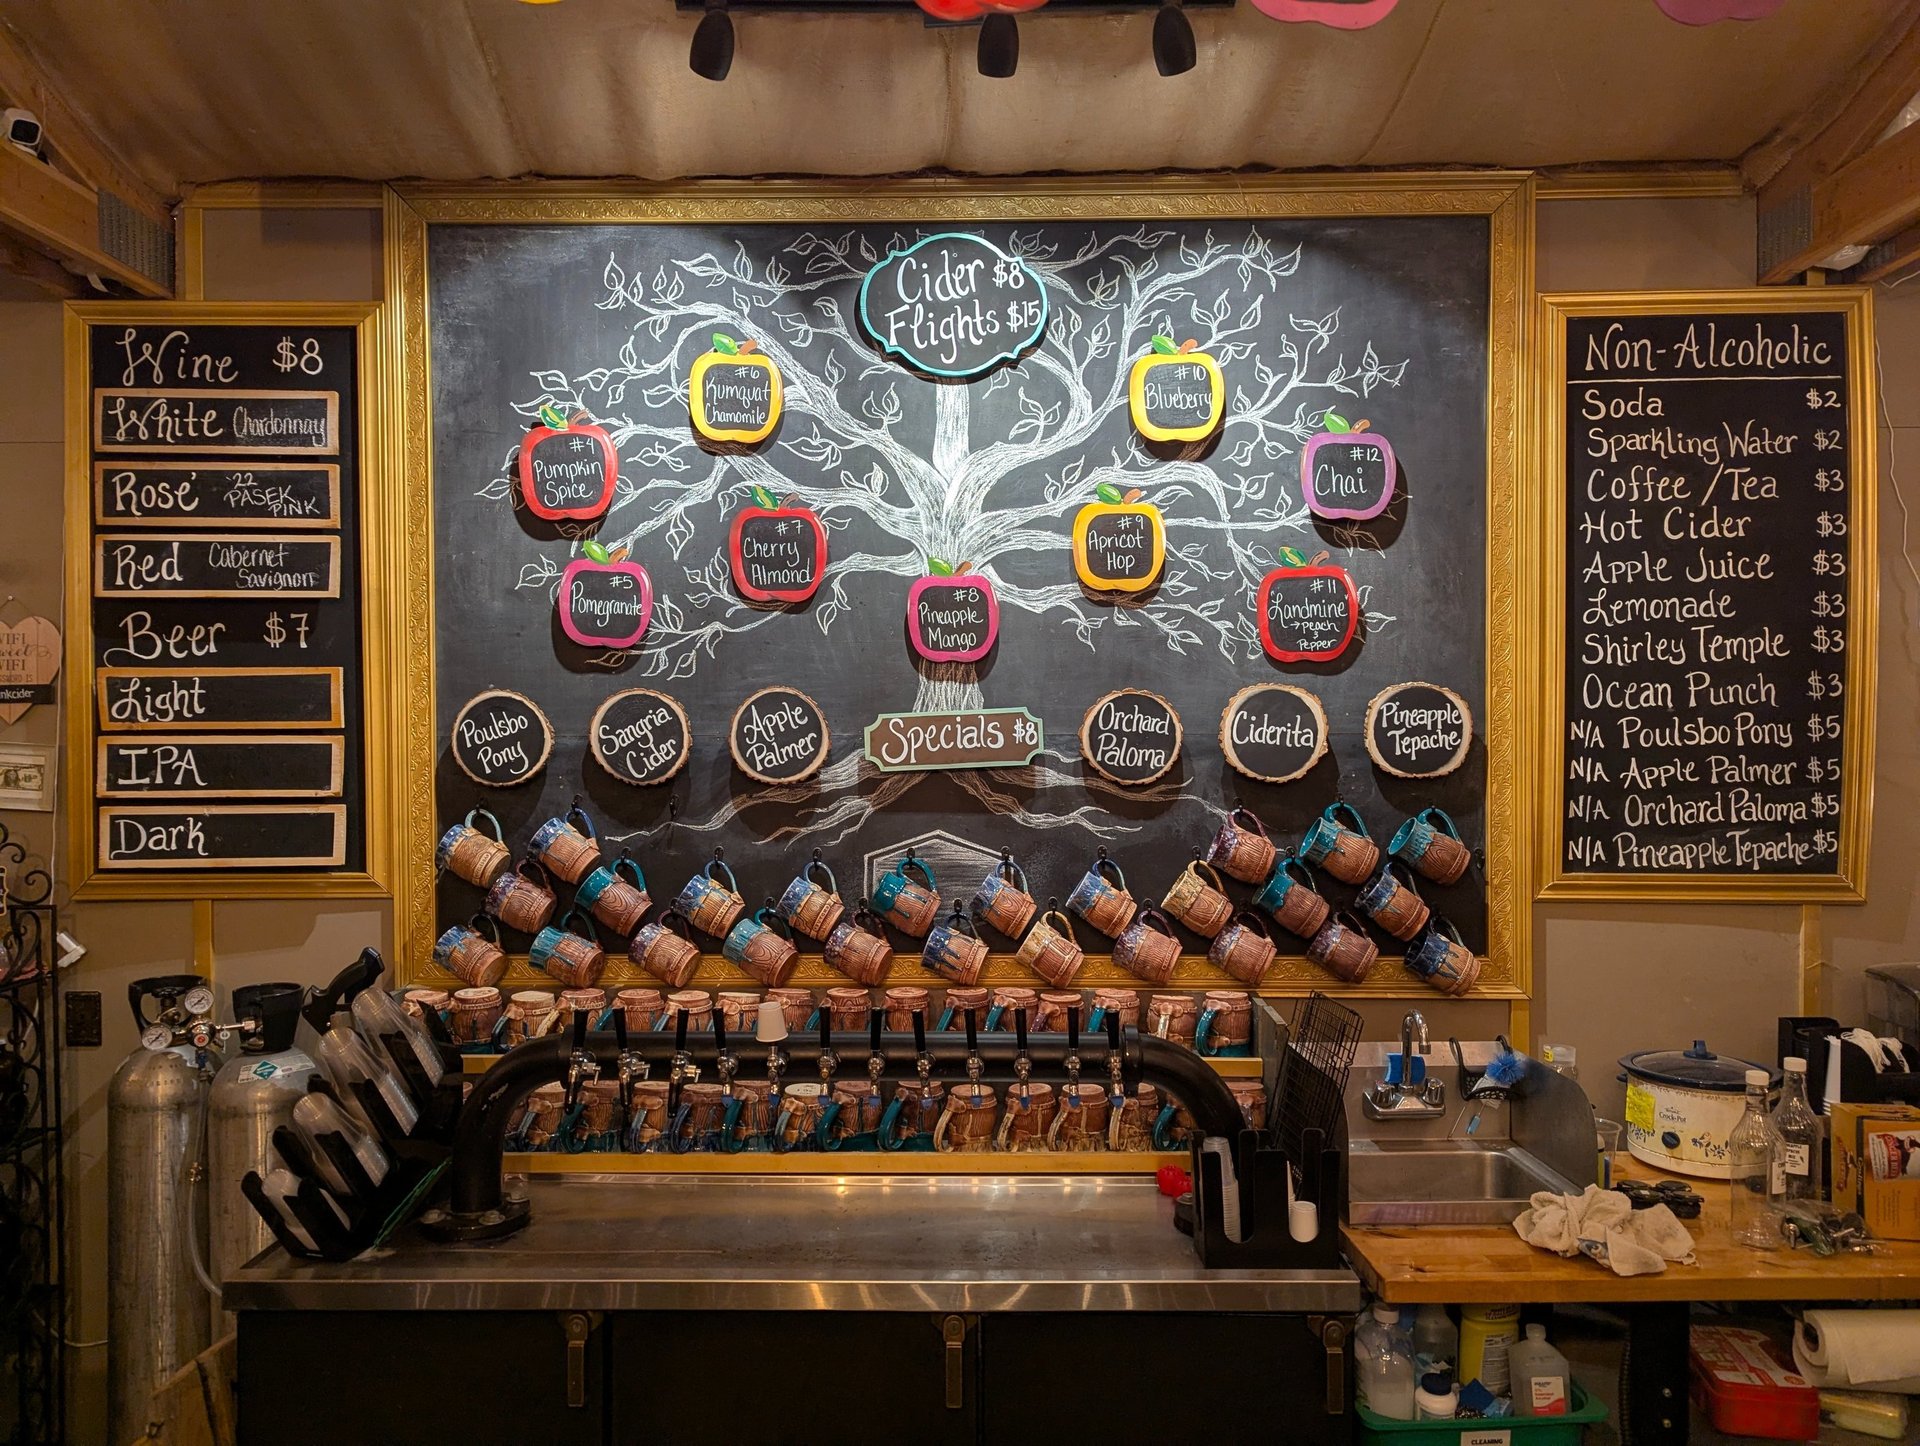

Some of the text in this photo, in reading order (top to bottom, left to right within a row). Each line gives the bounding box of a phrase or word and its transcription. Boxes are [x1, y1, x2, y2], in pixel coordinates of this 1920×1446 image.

[897, 249, 1025, 303] Cider $8
[884, 299, 1041, 365] Flights $15
[115, 328, 323, 386] Wine $8
[734, 366, 760, 379] #6
[1174, 366, 1207, 382] #10
[706, 380, 771, 411] Kumquat
[1144, 383, 1213, 419] Blueberry
[1582, 387, 1841, 421] Soda $2
[108, 397, 325, 447] White Chardonnay
[705, 403, 767, 425] Chamomile
[569, 437, 595, 454] #4
[1350, 447, 1383, 462] #12
[1587, 419, 1844, 465] Sparkling Water $2
[534, 460, 604, 482] Pumpkin
[1315, 463, 1367, 496] Chai
[1814, 468, 1844, 492] $3
[223, 484, 296, 508] PASEK
[268, 496, 320, 517] PINK
[544, 482, 594, 507] Spice
[775, 520, 804, 536] #7
[1117, 515, 1145, 530] #9
[1579, 506, 1847, 544] Hot Cider $3
[208, 542, 289, 568] Cabernet
[743, 537, 800, 567] Cherry
[1088, 530, 1144, 551] Apricot
[112, 542, 183, 589] Red
[751, 558, 815, 586] Almond
[1106, 551, 1136, 574] Hop
[1583, 547, 1847, 584] Apple Juice $3
[609, 575, 633, 589] #5
[952, 588, 980, 602] #8
[1309, 579, 1336, 594] #11
[571, 581, 646, 627] Pomegranate
[918, 603, 984, 628] Pineapple
[1582, 587, 1846, 627] Lemonade $3
[104, 611, 310, 667] Beer $7
[928, 628, 977, 652] Mango
[1297, 638, 1337, 651] Pepper
[1301, 620, 1340, 635] peach
[1582, 625, 1845, 666] Shirley Temple $3
[0, 688, 34, 699] nkcider
[111, 677, 206, 722] Light
[1582, 670, 1843, 710] Ocean Punch $3
[459, 711, 529, 749] Poulsbo
[598, 705, 673, 756] Sangria
[744, 702, 809, 745] Apple
[1098, 702, 1170, 736] Orchard
[1232, 710, 1314, 748] Ciderita
[1380, 701, 1462, 731] Pineapple
[1570, 712, 1841, 749] N/A Poulsbo Pony $5
[745, 731, 818, 771] Palmer
[881, 715, 1039, 765] Specials $8
[1096, 733, 1167, 769] Paloma
[1387, 728, 1461, 760] Tepache
[117, 745, 208, 786] IPA
[476, 740, 529, 775] Pony
[625, 738, 677, 779] Cider
[1569, 754, 1841, 789] N/A Apple Palmer $5
[1568, 787, 1840, 827] N/A Orchard Paloma $5
[111, 817, 209, 859] Dark
[1568, 828, 1838, 870] N/A Pineapple Tepache $5
